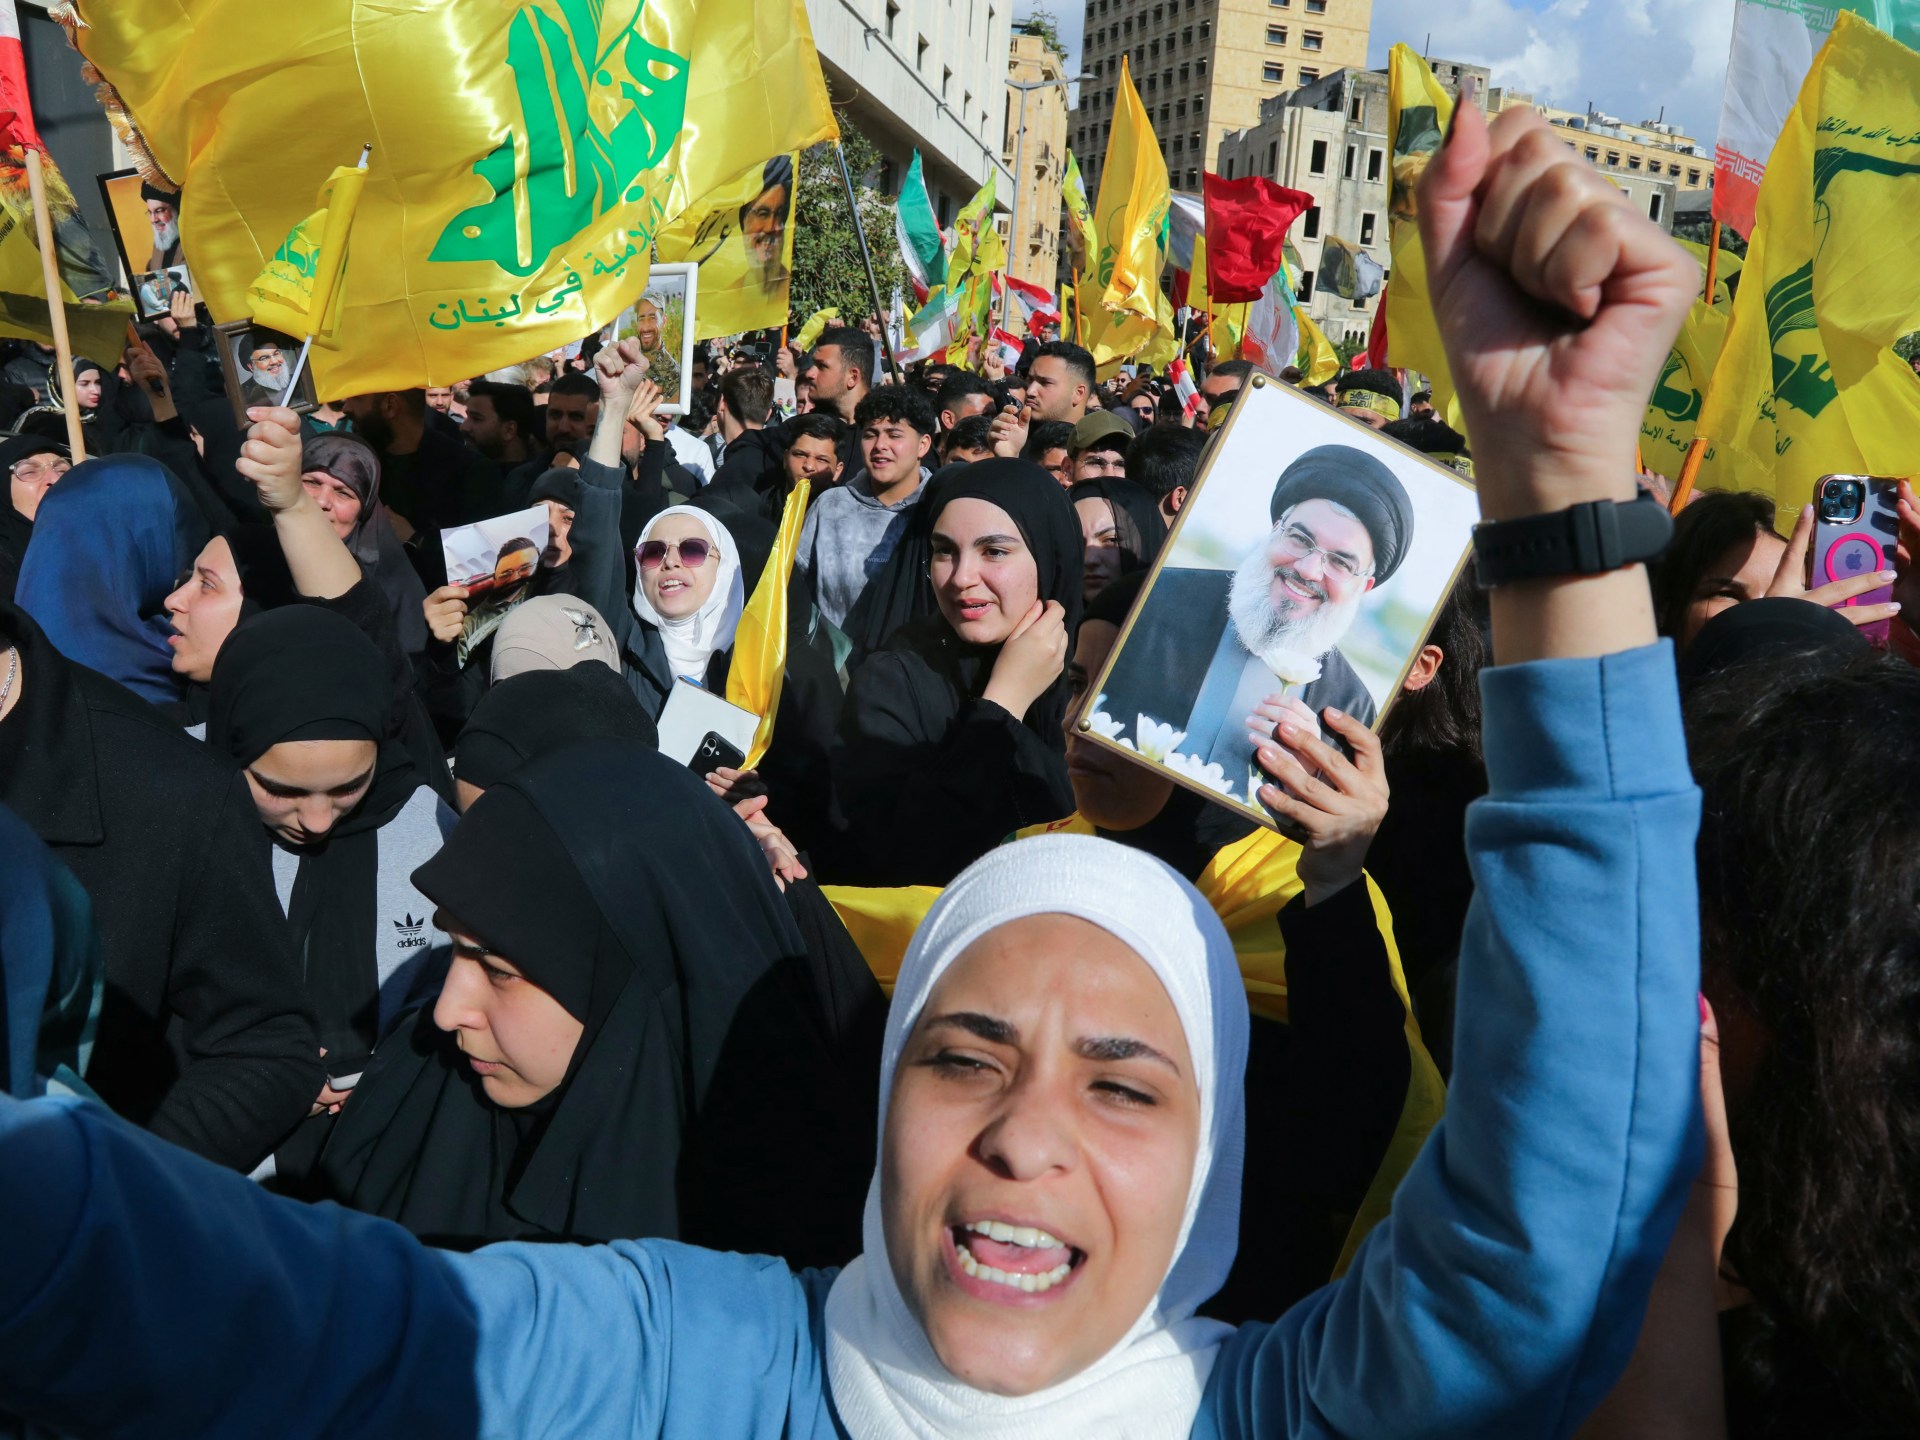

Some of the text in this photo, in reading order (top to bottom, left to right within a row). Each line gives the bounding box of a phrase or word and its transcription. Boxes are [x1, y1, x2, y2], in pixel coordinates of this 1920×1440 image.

[535, 266, 583, 316] في
[429, 293, 521, 330] لبنان
[1641, 421, 1716, 462] الومة الإسلا
[397, 937, 427, 948] adidas
